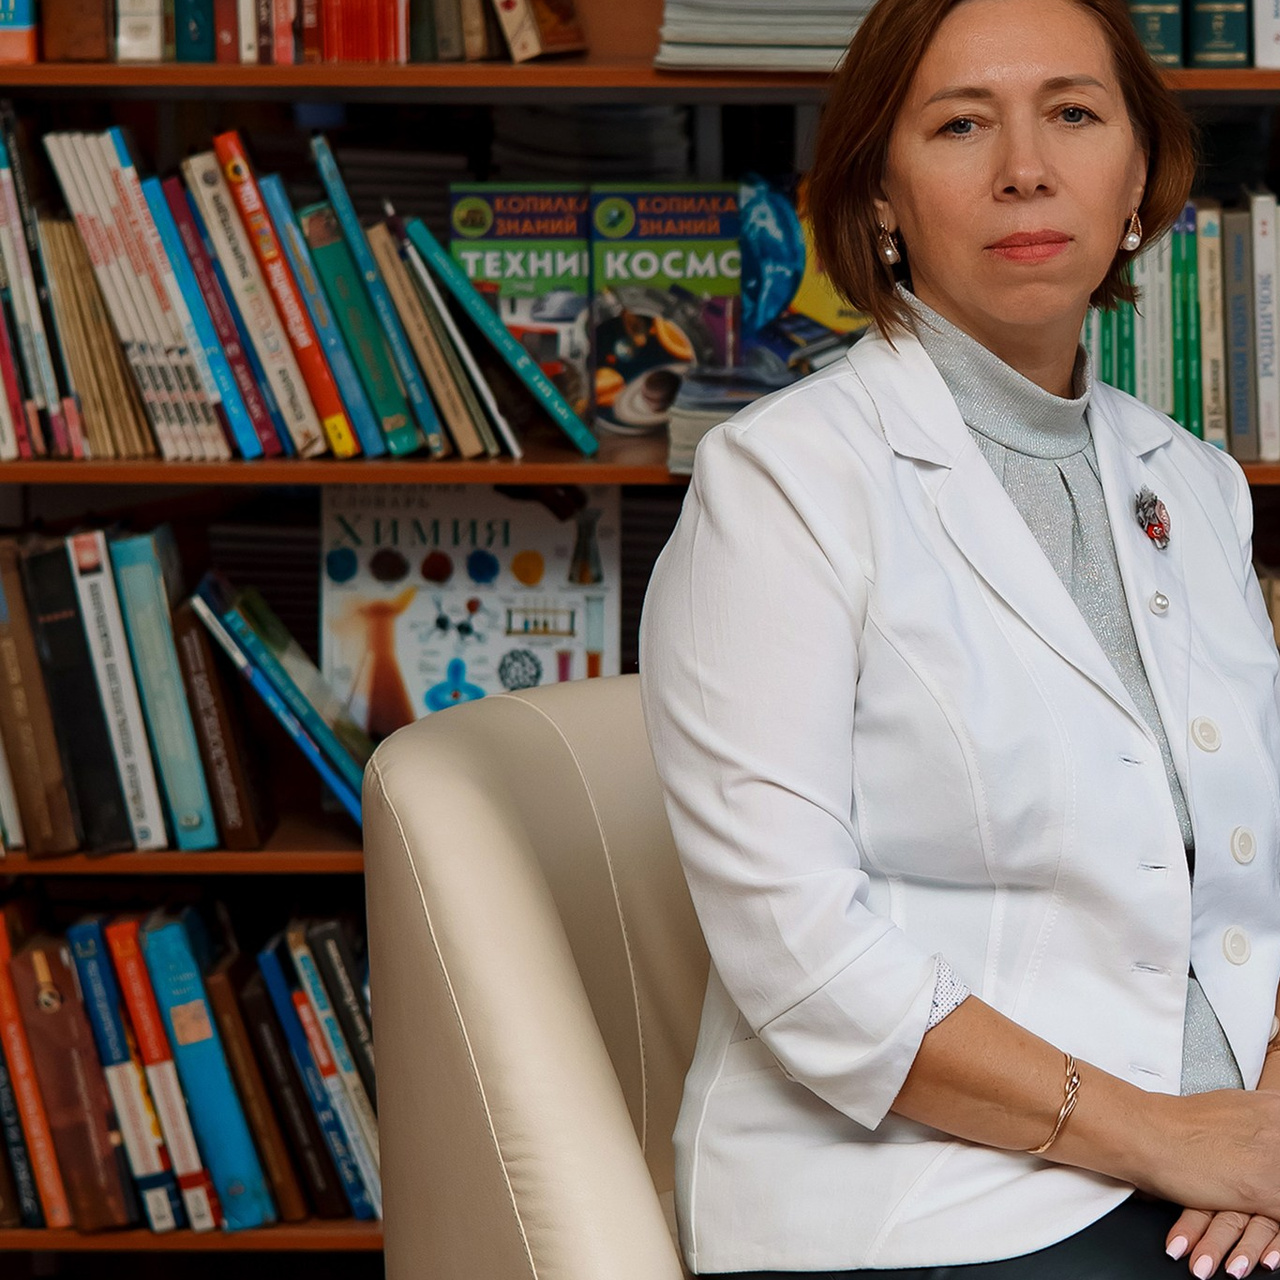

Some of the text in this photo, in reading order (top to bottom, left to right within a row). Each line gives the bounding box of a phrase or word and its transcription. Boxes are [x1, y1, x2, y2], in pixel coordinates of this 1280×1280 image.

[637, 197, 738, 214] КОПИЛКА
[495, 217, 577, 236] ЗНАНИЙ
[638, 217, 720, 236] ЗНАНИЙ
[1260, 273, 1275, 377] РОДНИЧОК
[333, 514, 511, 547] ХИМИЯ
